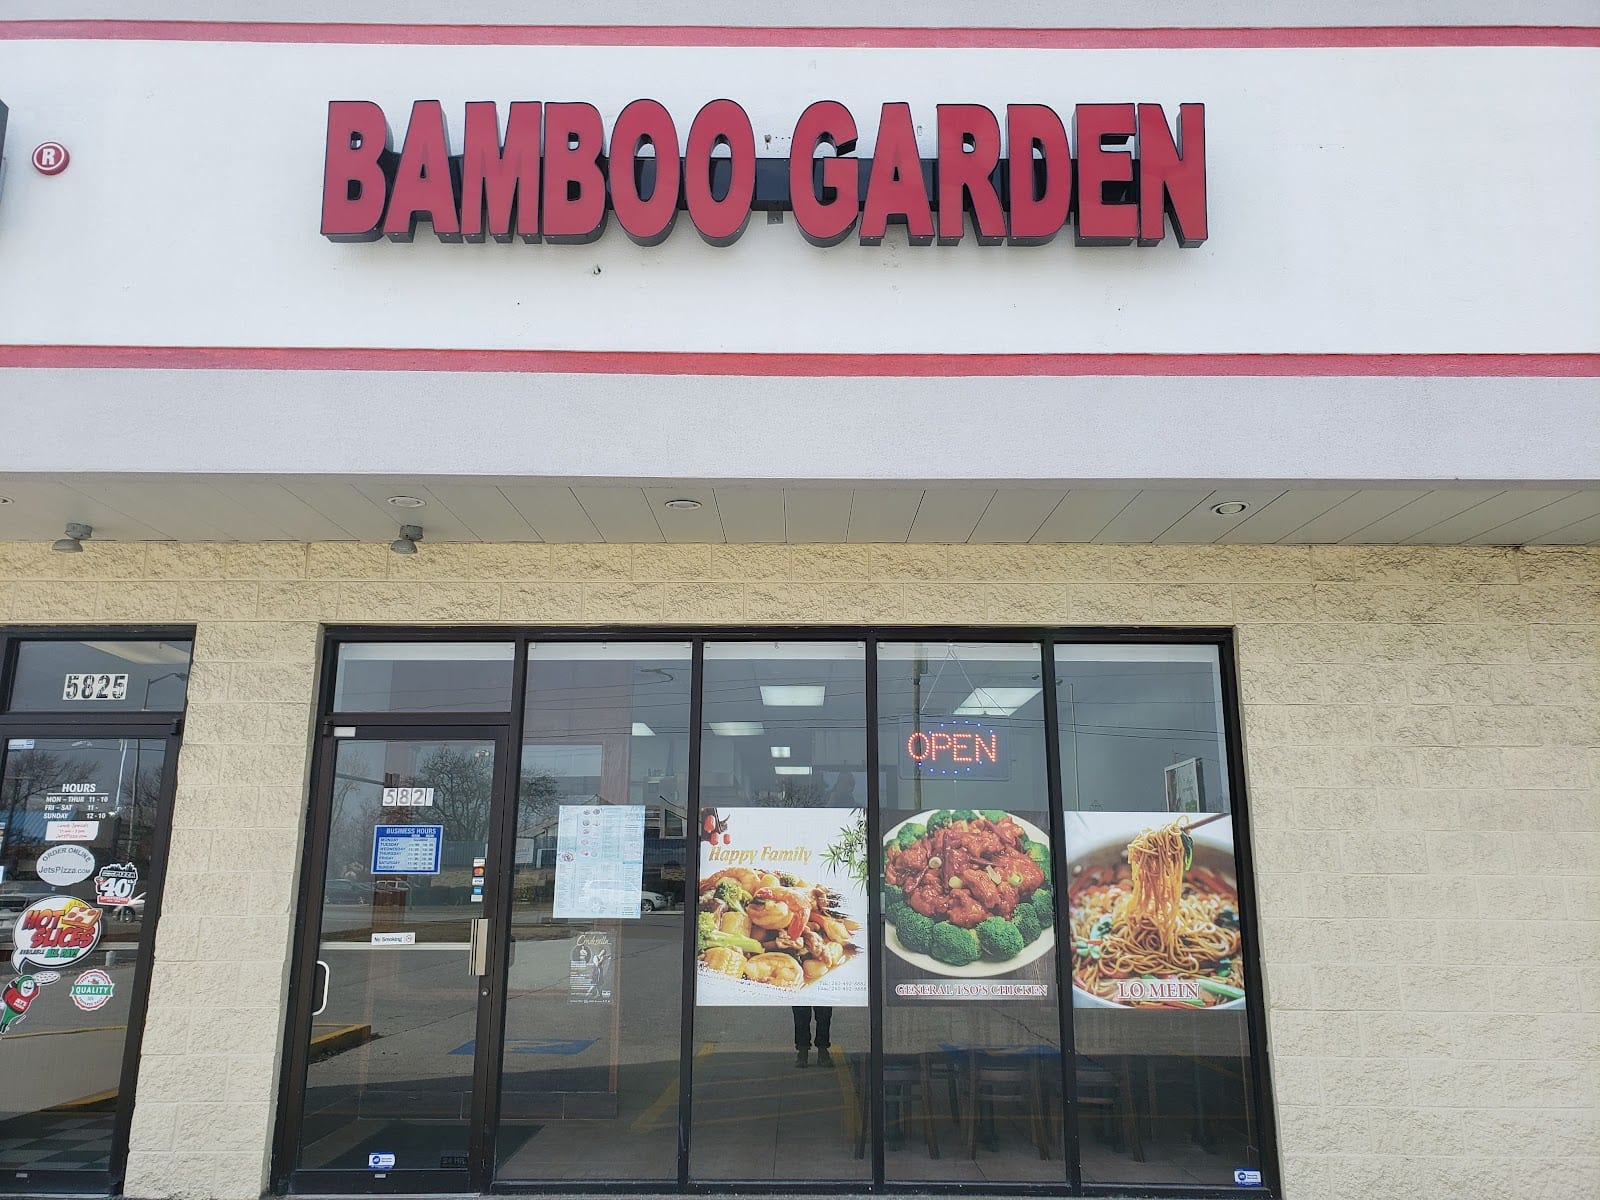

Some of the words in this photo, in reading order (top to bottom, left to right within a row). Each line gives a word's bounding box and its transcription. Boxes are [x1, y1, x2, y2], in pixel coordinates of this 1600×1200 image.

[320, 98, 757, 245] BAMBOO
[789, 100, 1208, 246] GARDEN
[65, 674, 127, 700] 5825
[907, 731, 997, 762] OPEN
[61, 783, 97, 793] HOURS
[43, 812, 69, 820] SUNDAY
[386, 827, 416, 835] BUSINESS
[416, 827, 437, 835] HOURS
[42, 848, 67, 862] ORDER
[68, 847, 92, 863] ONLINE
[708, 846, 758, 864] Happy
[760, 845, 813, 865] Family
[22, 909, 65, 930] HOT
[31, 927, 95, 948] SLICES
[45, 948, 60, 958] ALL
[75, 985, 109, 995] QUALITY
[895, 983, 954, 997] GENERAL
[990, 984, 1049, 997] CHICKEN
[1117, 981, 1146, 1000] LO
[1148, 981, 1201, 1000] MEIN
